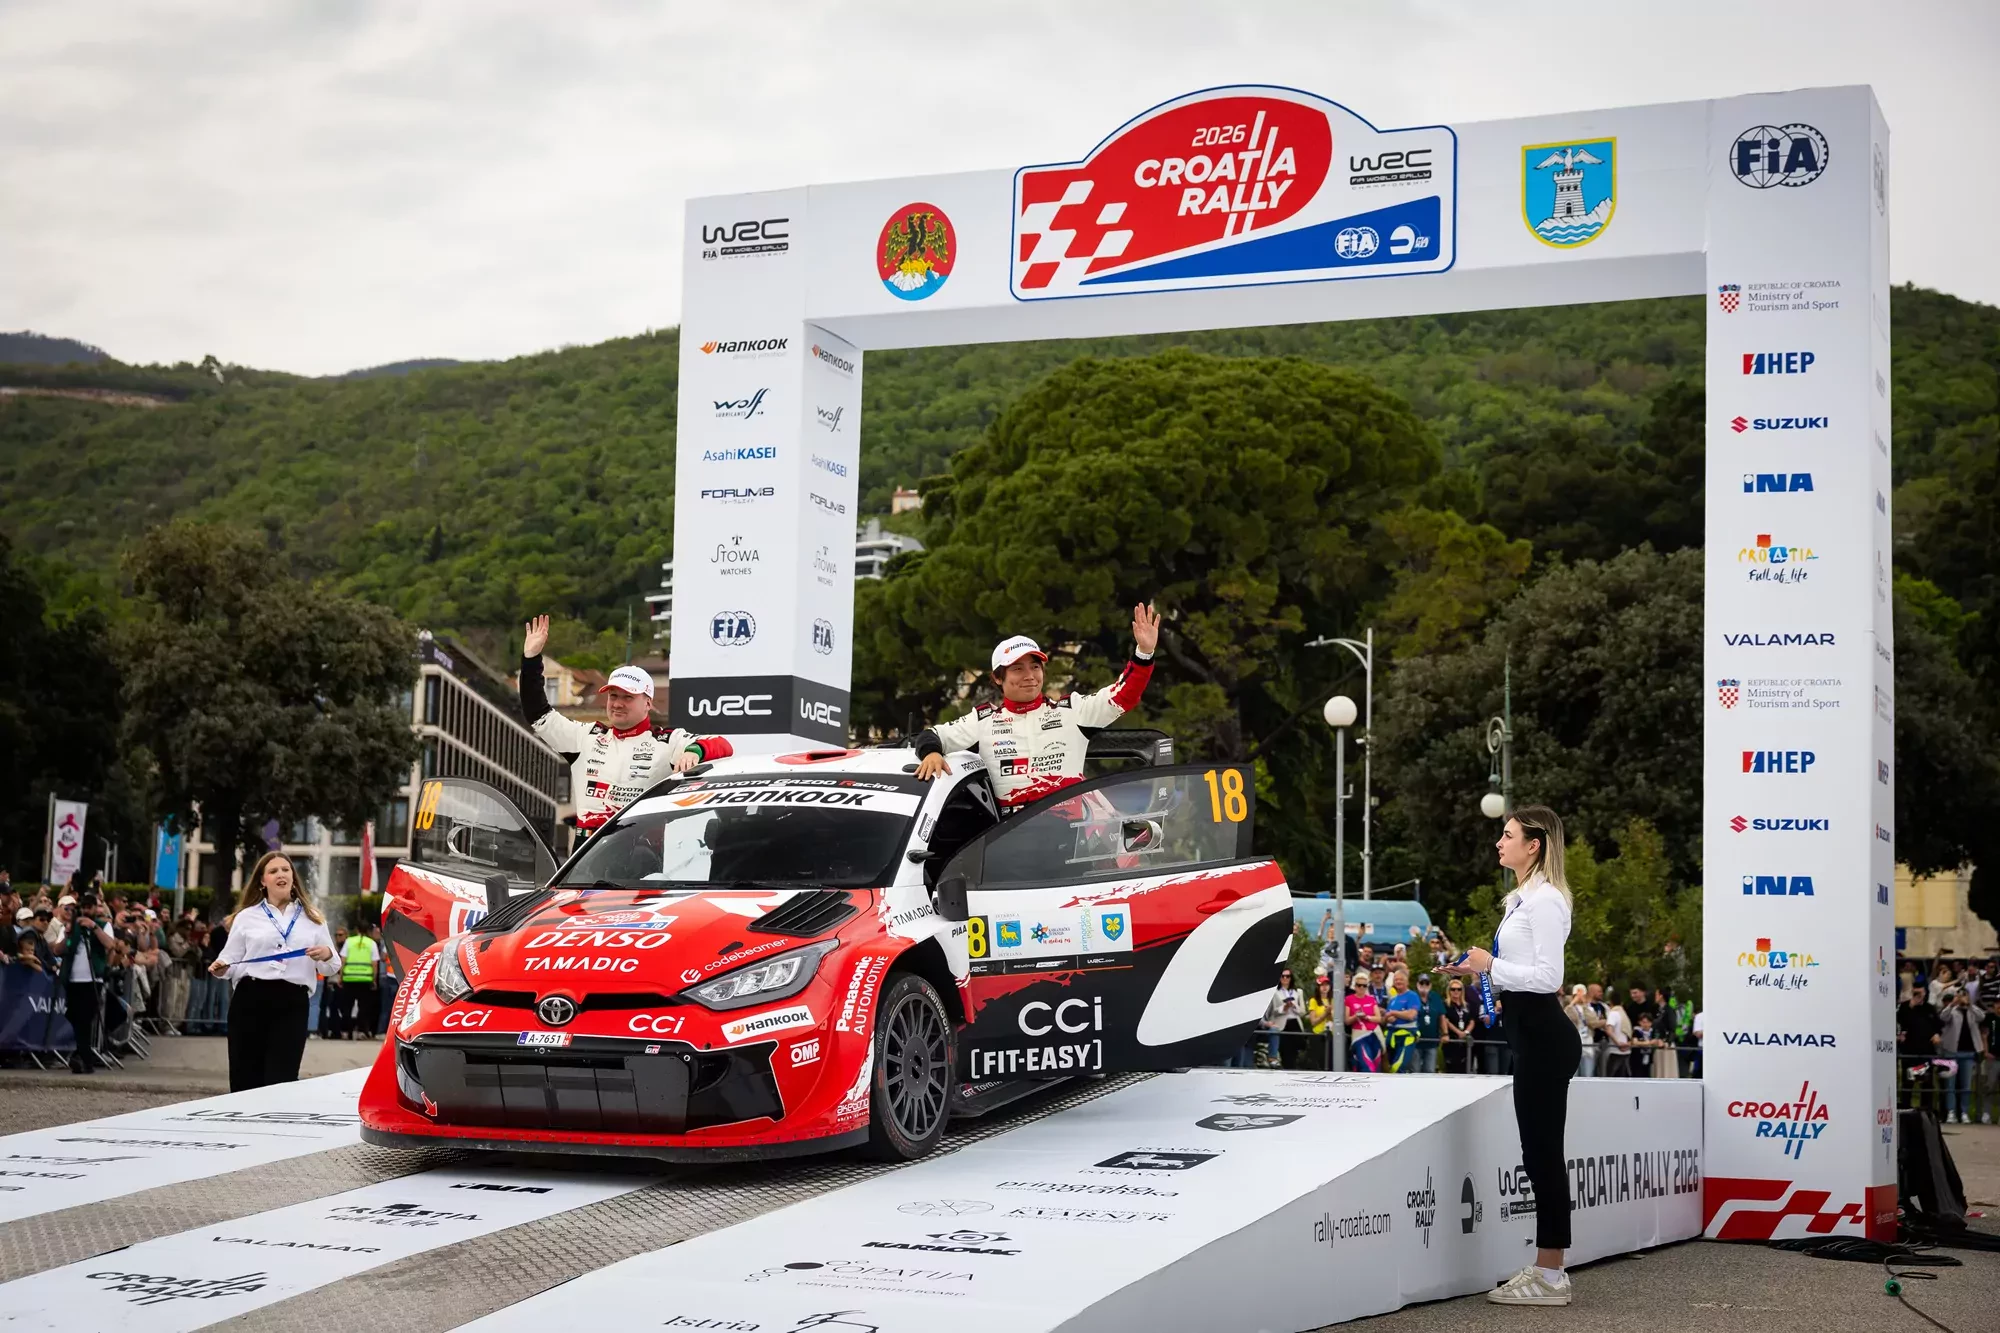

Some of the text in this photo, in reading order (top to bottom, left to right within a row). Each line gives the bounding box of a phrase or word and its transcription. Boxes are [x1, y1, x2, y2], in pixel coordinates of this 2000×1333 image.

[1192, 124, 1247, 147] 2026
[1134, 128, 1297, 188] CROATIA
[1350, 149, 1432, 172] WRC
[1399, 172, 1430, 180] RALLY
[1177, 179, 1294, 222] RALLY
[703, 218, 789, 243] WRC
[1748, 280, 1841, 291] REPUBLIC OF CROATIA
[1748, 291, 1804, 303] Ministry of
[1748, 300, 1839, 312] Tourism and Sport
[1768, 352, 1815, 374] HEP
[1753, 417, 1828, 430] SUZUKI
[701, 487, 774, 499] FORUM8
[711, 544, 760, 563] STOWA
[1738, 546, 1819, 563] CROATIA
[720, 567, 752, 576] WATCHES
[1749, 568, 1771, 583] Full
[1791, 568, 1808, 583] life
[1724, 634, 1835, 646] VALAMAR
[1747, 679, 1841, 687] REPUBLIC OF CROATIA
[1747, 688, 1804, 699] Ministry of
[688, 695, 772, 717] WRC
[800, 697, 841, 727] WRC
[1747, 699, 1840, 710] Tourism and Sport
[1032, 752, 1065, 762] TOYOTA
[1767, 751, 1815, 773] HEP
[1001, 765, 1028, 776] GR
[1030, 765, 1062, 774] Racing
[612, 785, 644, 793] TOYOTA
[706, 779, 769, 789] TOYOTA
[773, 778, 838, 787] GAZOO
[838, 780, 900, 792] Racing
[1204, 768, 1248, 823] 18
[415, 781, 443, 830] 18
[920, 817, 934, 841] CENTRAL
[1752, 818, 1829, 831] SUZUKI
[893, 904, 933, 926] TAMADIC
[524, 931, 672, 949] DENSO
[951, 924, 968, 938] PIAA
[523, 956, 639, 973] TAMADIC
[704, 940, 787, 972] codebeamer
[1737, 951, 1819, 968] CROATIA
[392, 951, 431, 1026] AUTOMOTIVE
[1748, 973, 1771, 987] Full
[1791, 973, 1808, 989] life
[836, 955, 873, 1033] Panasonic
[854, 955, 888, 1036] AUTOMOTIVE
[1485, 992, 1495, 1014] RALLY
[528, 1034, 562, 1044] A-7651
[1722, 1032, 1836, 1047] VALAMAR
[790, 1043, 820, 1063] OMP
[1727, 1098, 1829, 1121] CROATIA
[1755, 1121, 1827, 1142] RALLY
[1498, 1165, 1536, 1196] WR
[1566, 1149, 1699, 1211] CROATIA RALLY 2026
[1406, 1185, 1436, 1209] CROATIA
[1313, 1208, 1391, 1248] rally-croatia.com
[1415, 1209, 1436, 1229] RALLY
[212, 1236, 382, 1253] VALAMAR
[861, 1241, 1022, 1256] KARLOVAC
[833, 1265, 975, 1281] OPATIJA
[86, 1272, 269, 1293] CROATIA
[102, 1283, 240, 1302] RALLY
[661, 1315, 761, 1332] Istria
